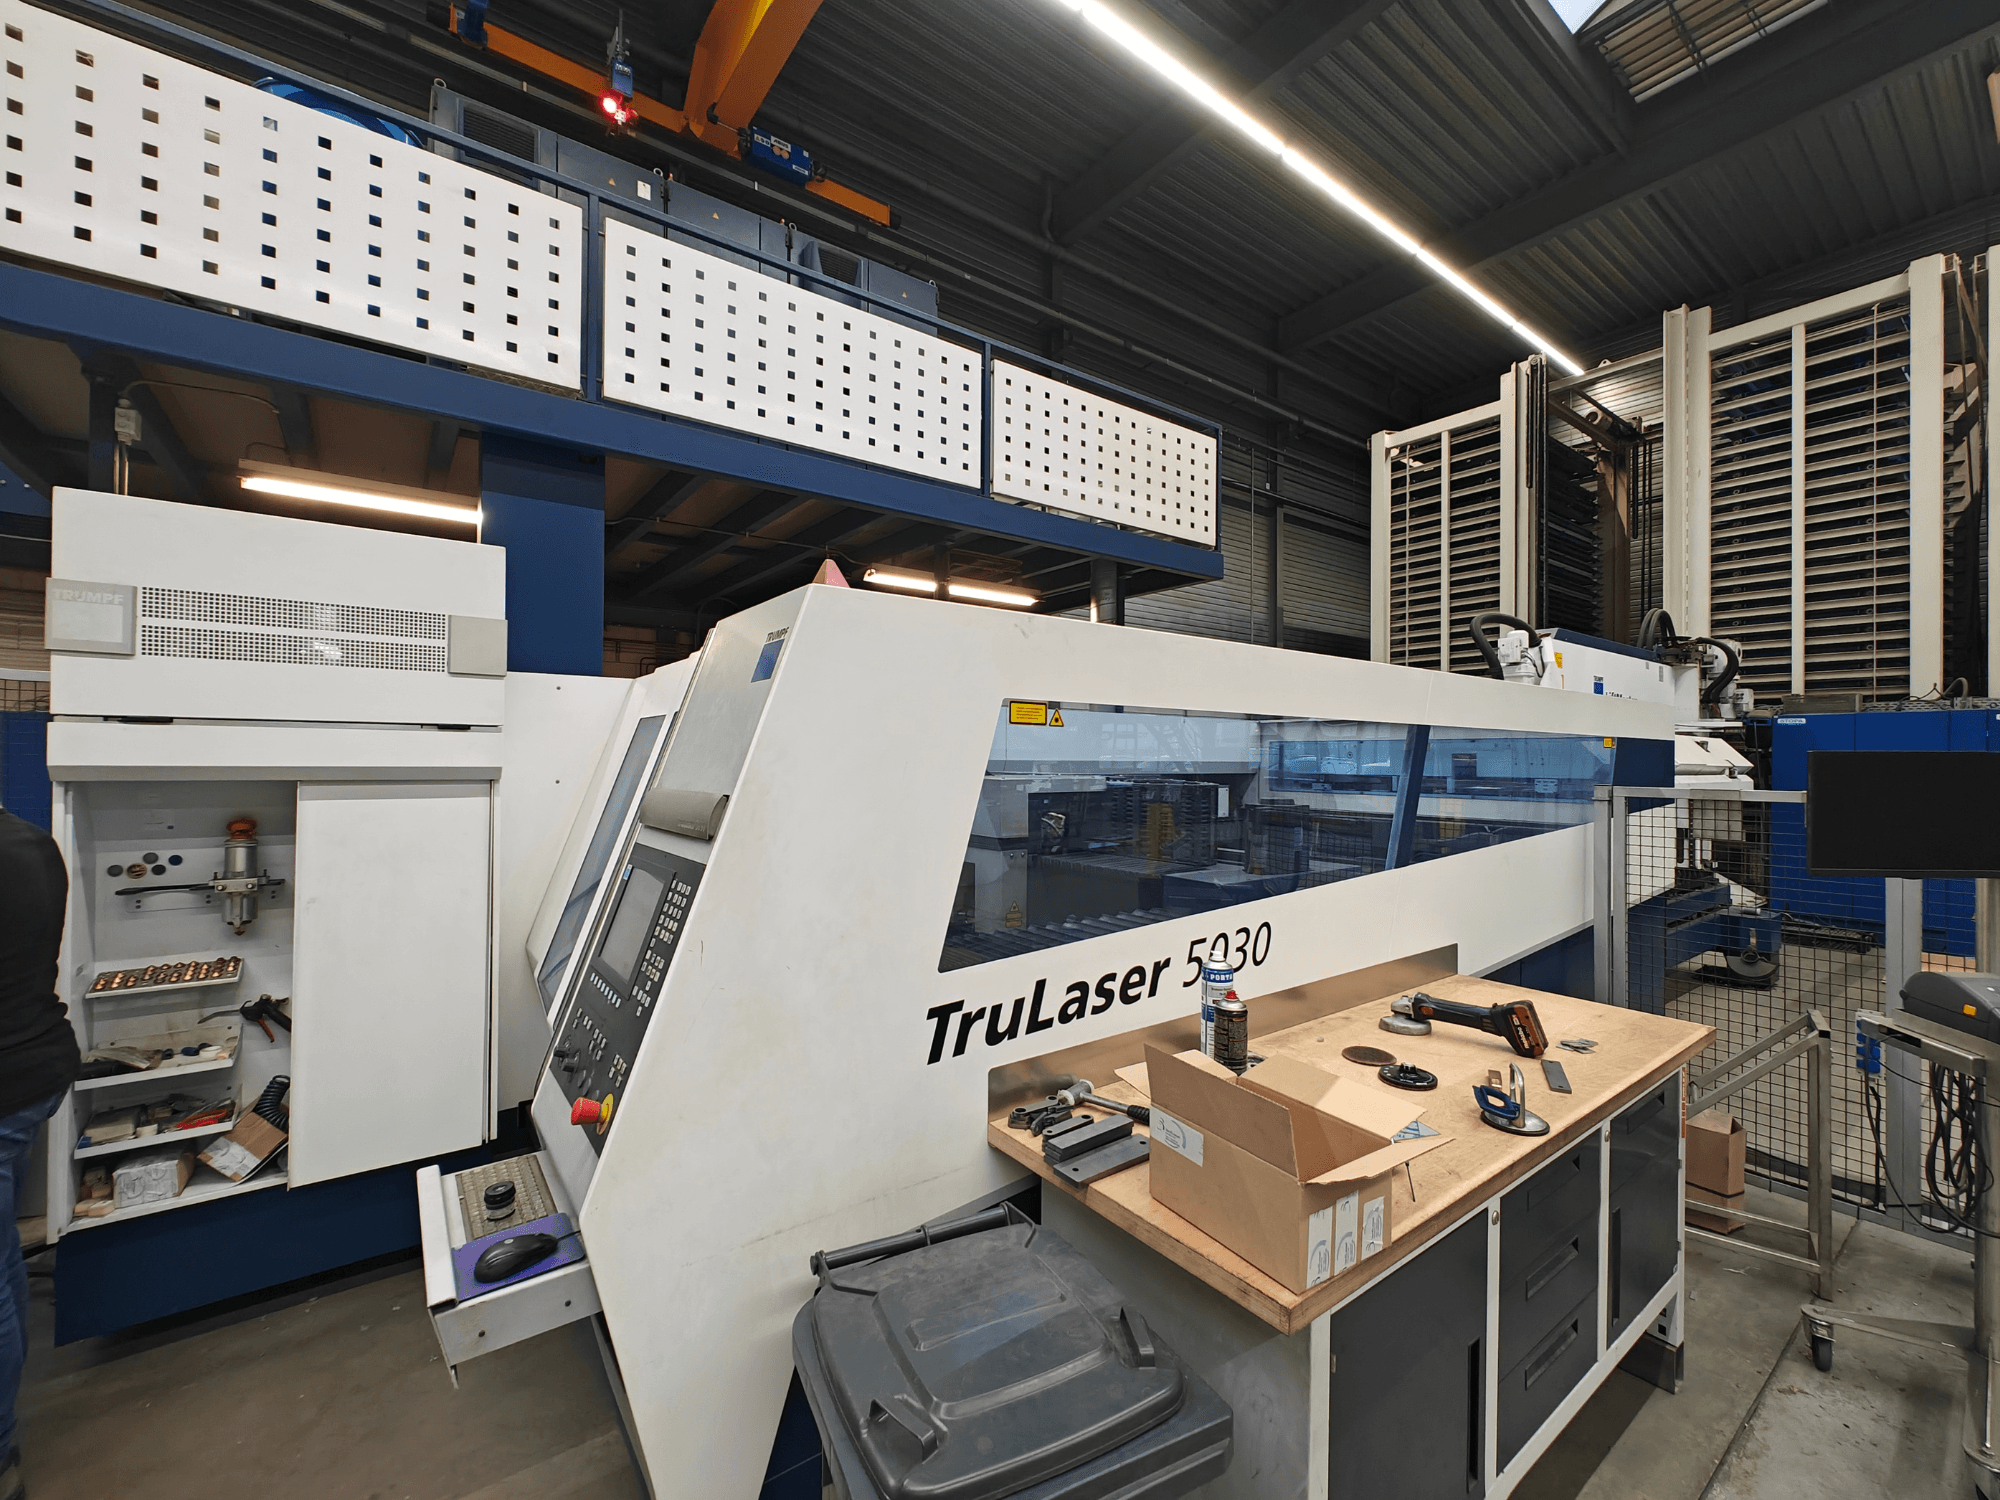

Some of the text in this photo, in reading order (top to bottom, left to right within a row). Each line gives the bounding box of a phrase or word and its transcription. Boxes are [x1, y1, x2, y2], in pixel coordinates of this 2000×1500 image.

[52, 588, 124, 604] TRUMPF
[925, 921, 1272, 1066] TruLaser 5030
